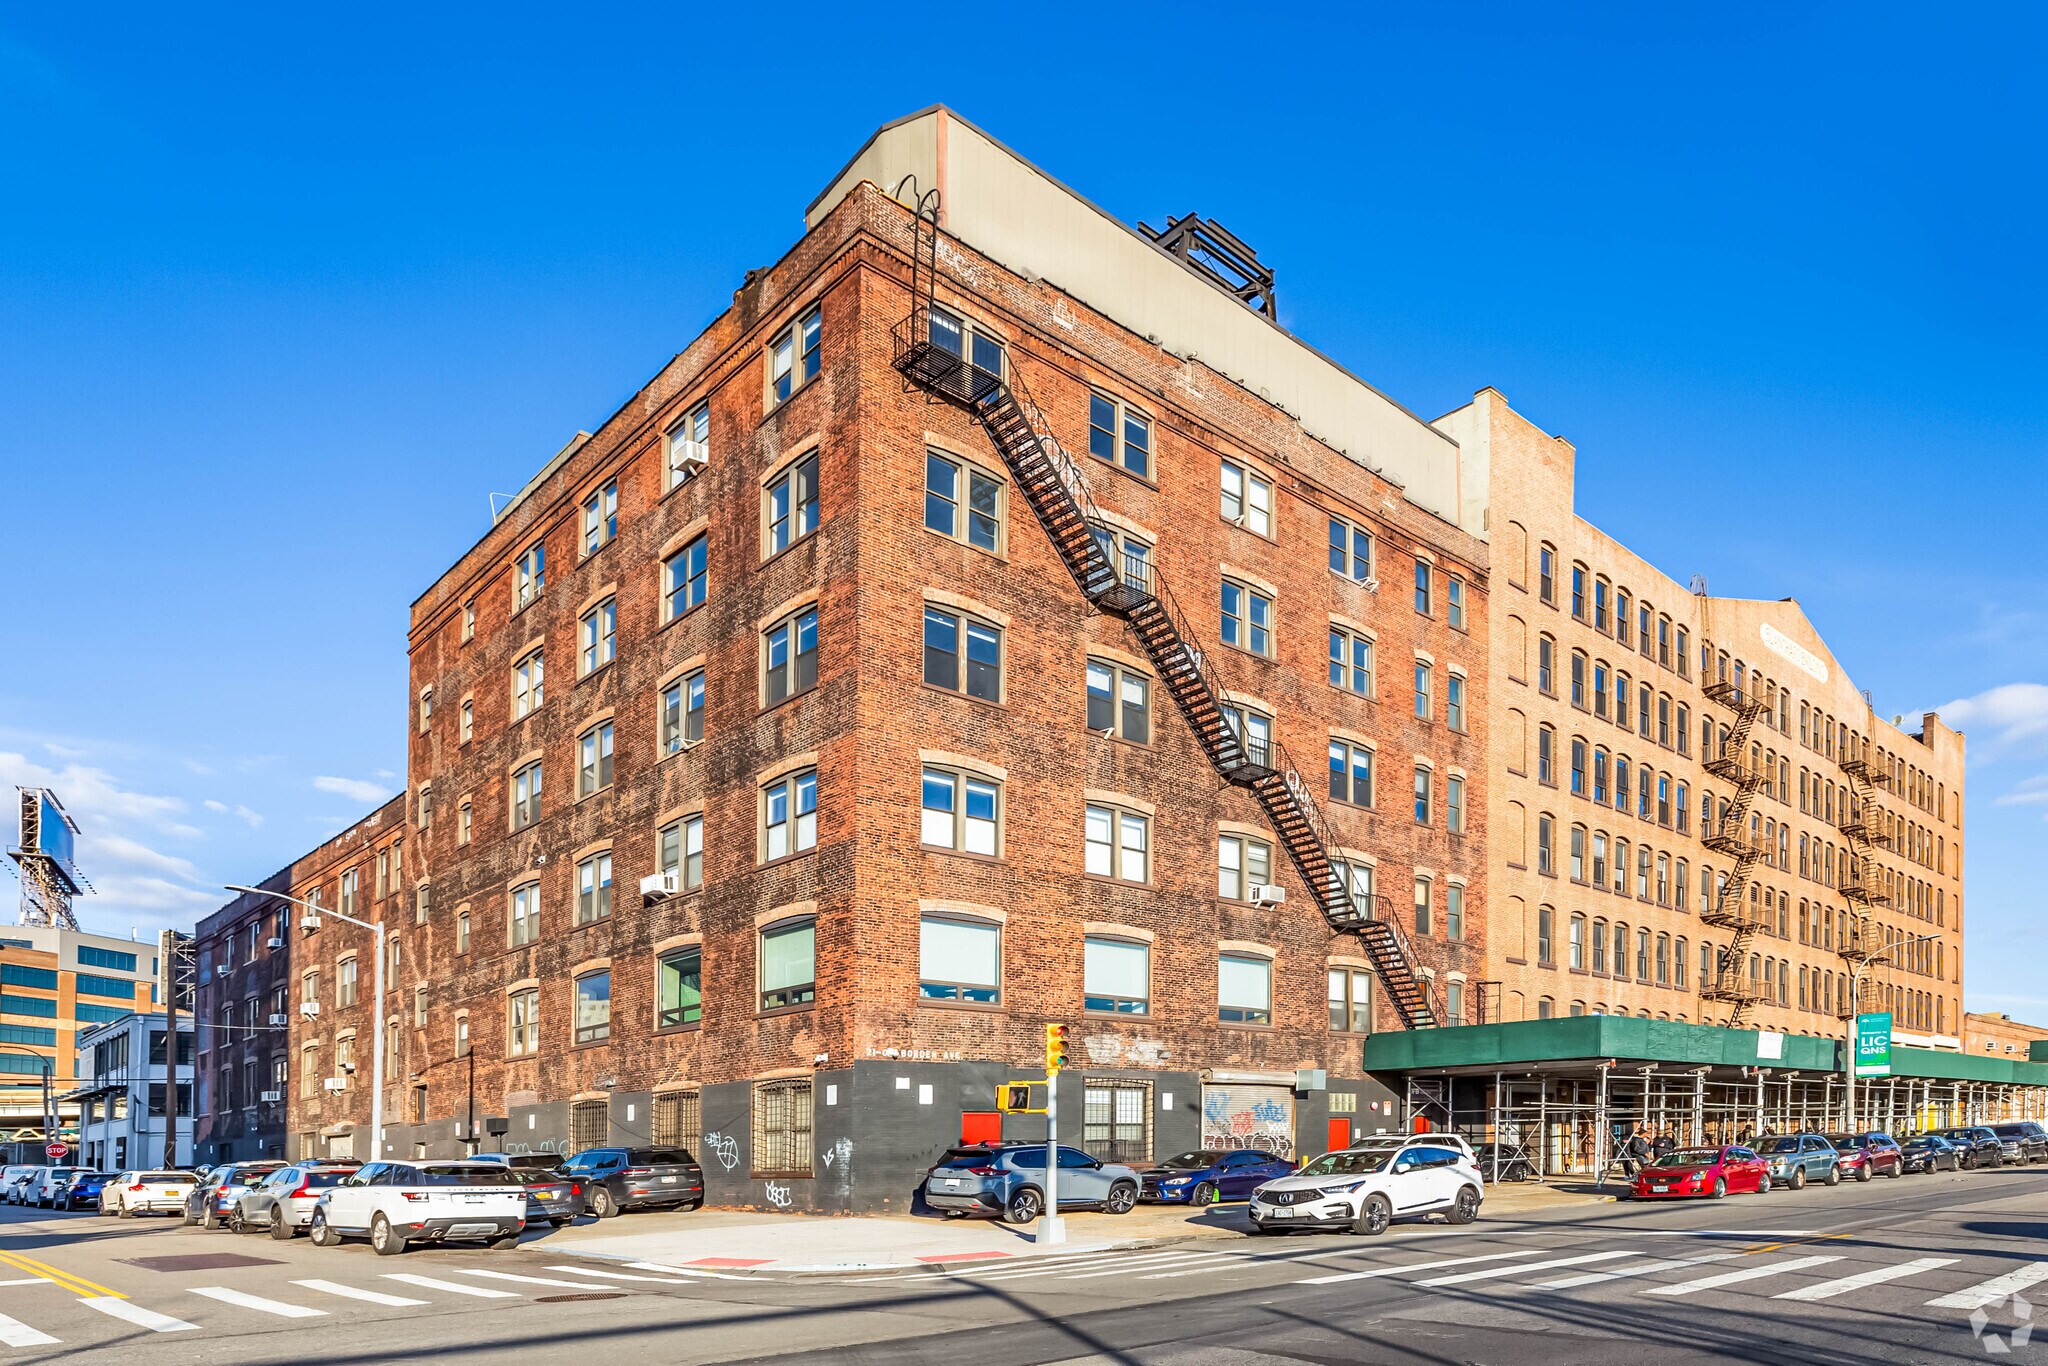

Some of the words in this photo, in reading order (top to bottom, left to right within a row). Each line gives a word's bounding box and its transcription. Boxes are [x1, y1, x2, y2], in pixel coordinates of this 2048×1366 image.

[1861, 1035, 1887, 1047] LIC
[901, 1049, 937, 1058] BORDEN
[943, 1051, 961, 1060] AVE
[1860, 1046, 1886, 1055] QNS
